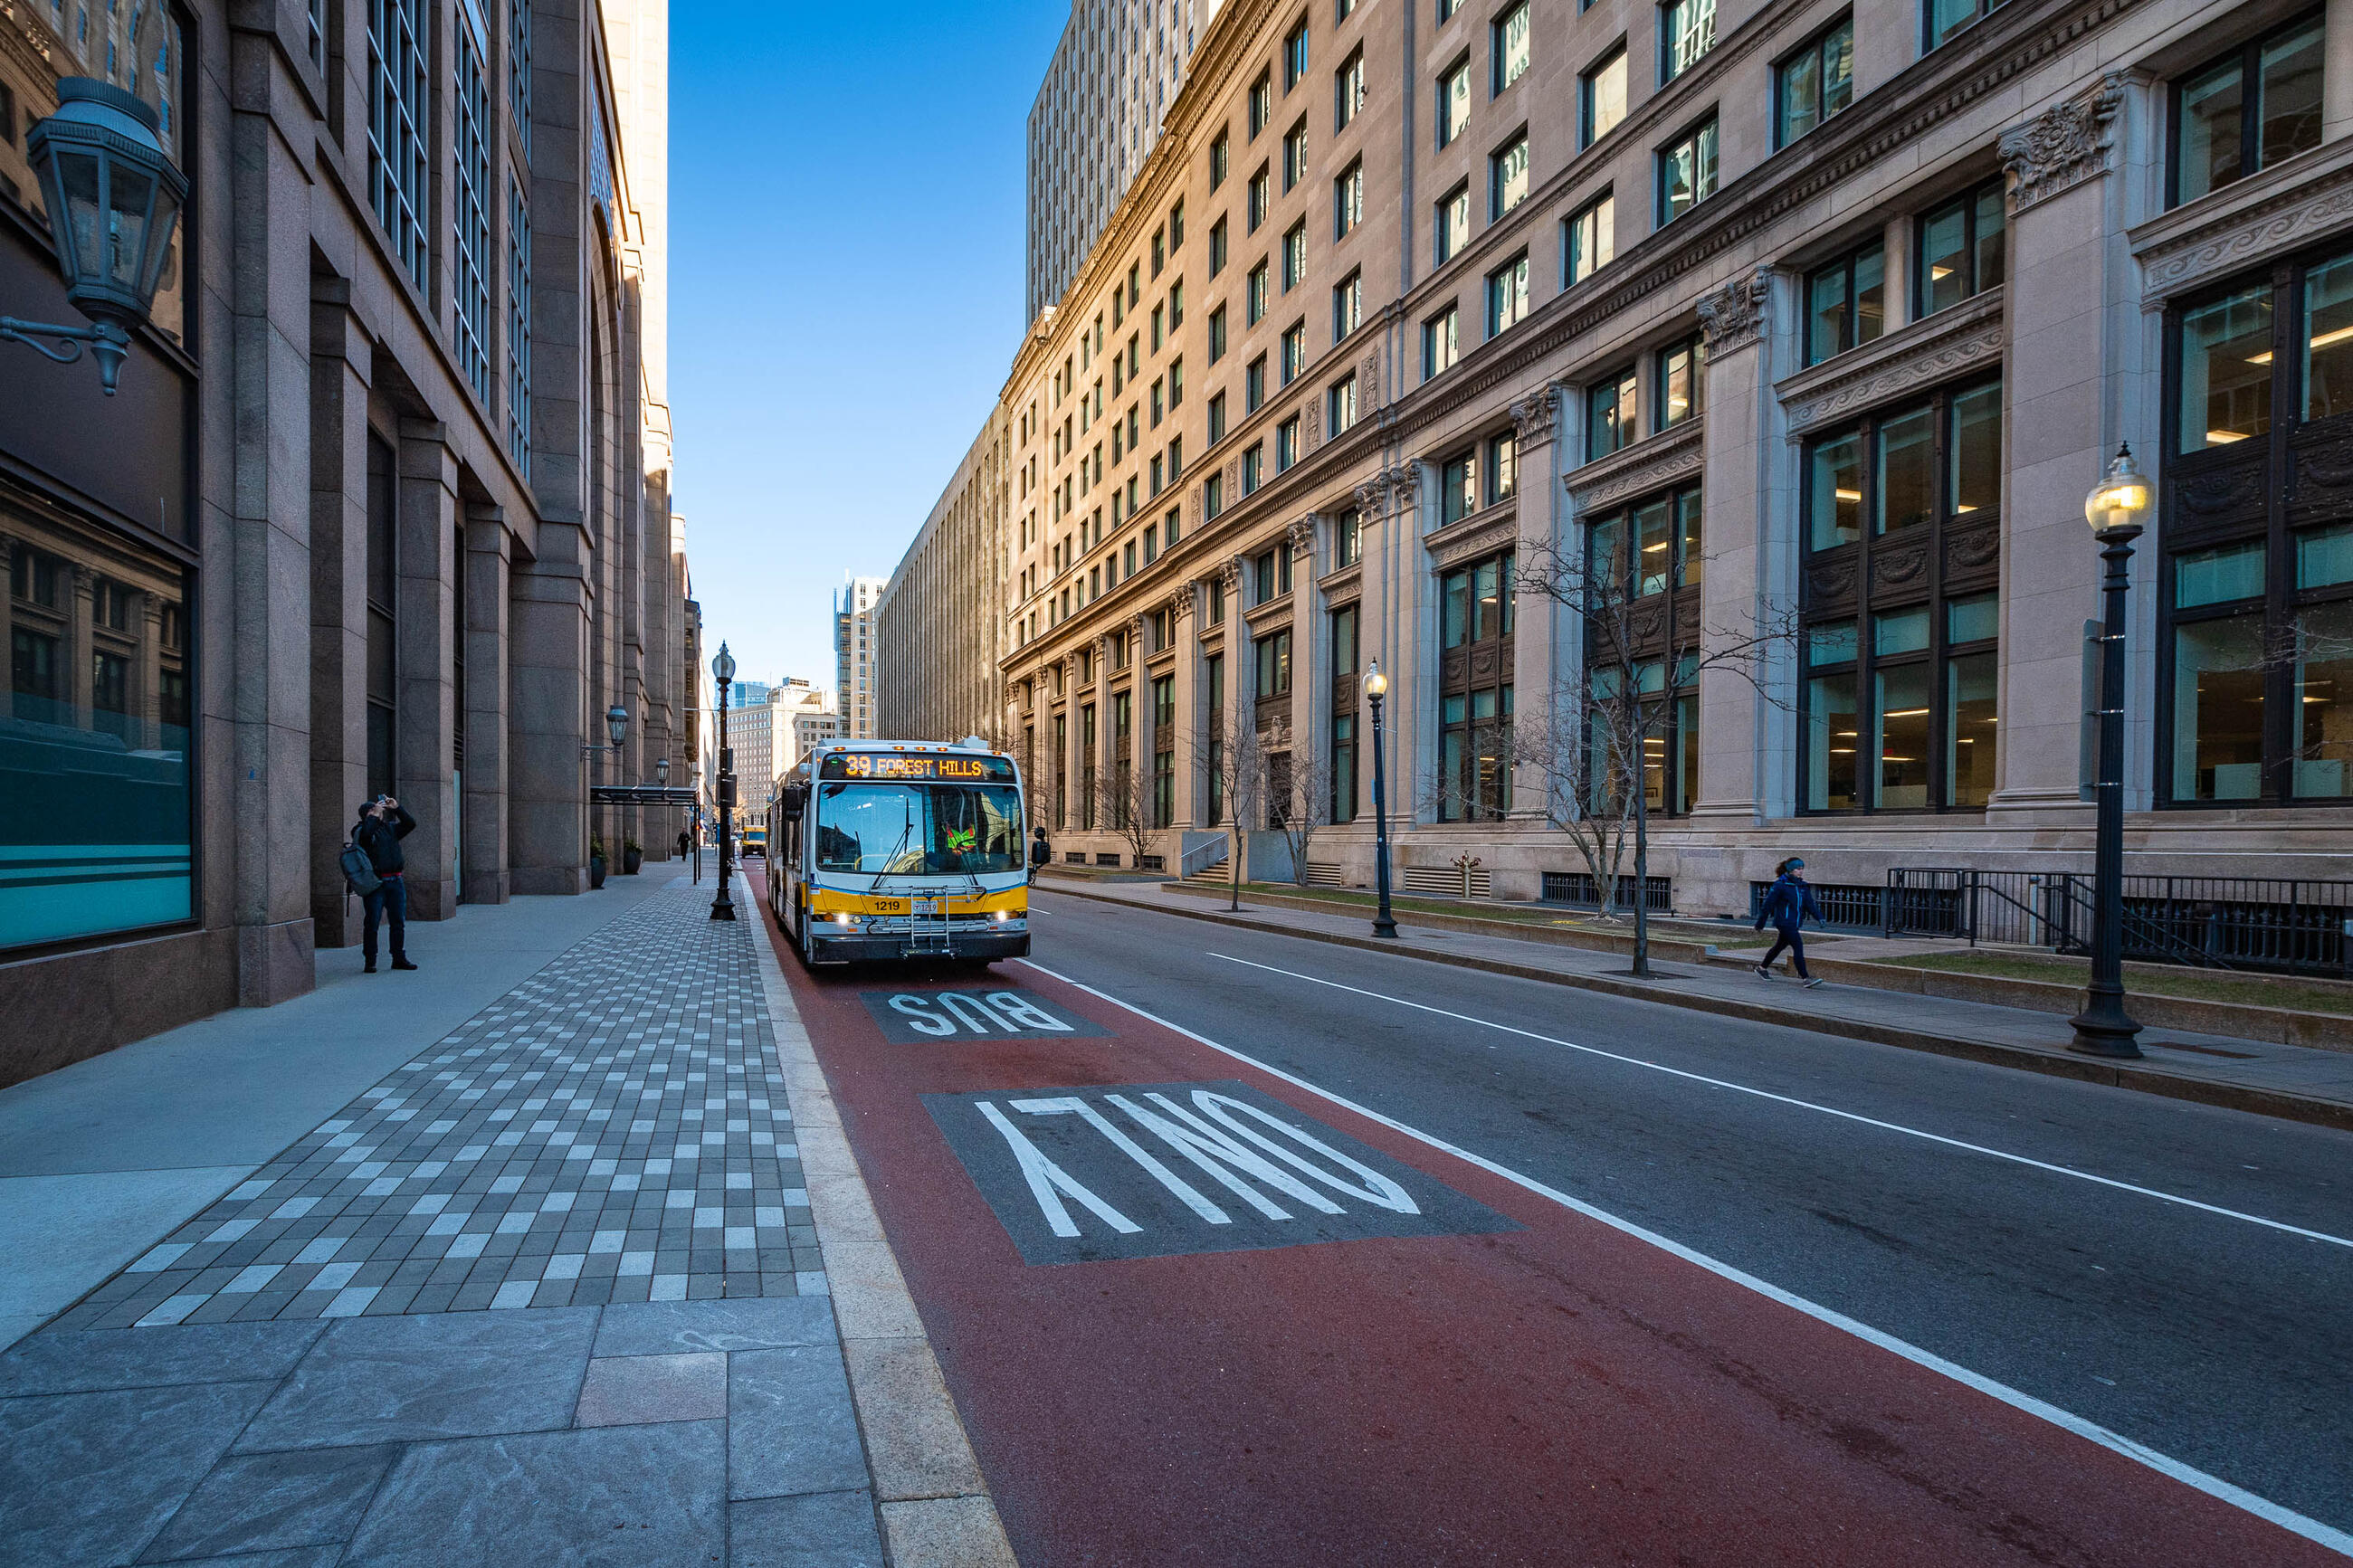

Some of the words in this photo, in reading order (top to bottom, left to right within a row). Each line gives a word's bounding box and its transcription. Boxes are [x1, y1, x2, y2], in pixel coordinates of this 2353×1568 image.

[845, 755, 871, 777] 39
[876, 758, 933, 775] FOREST
[938, 760, 982, 776] HILLS
[874, 900, 900, 911] 1219
[921, 904, 937, 912] 1219
[887, 991, 1075, 1037] BUS
[974, 1089, 1421, 1238] ONLY
